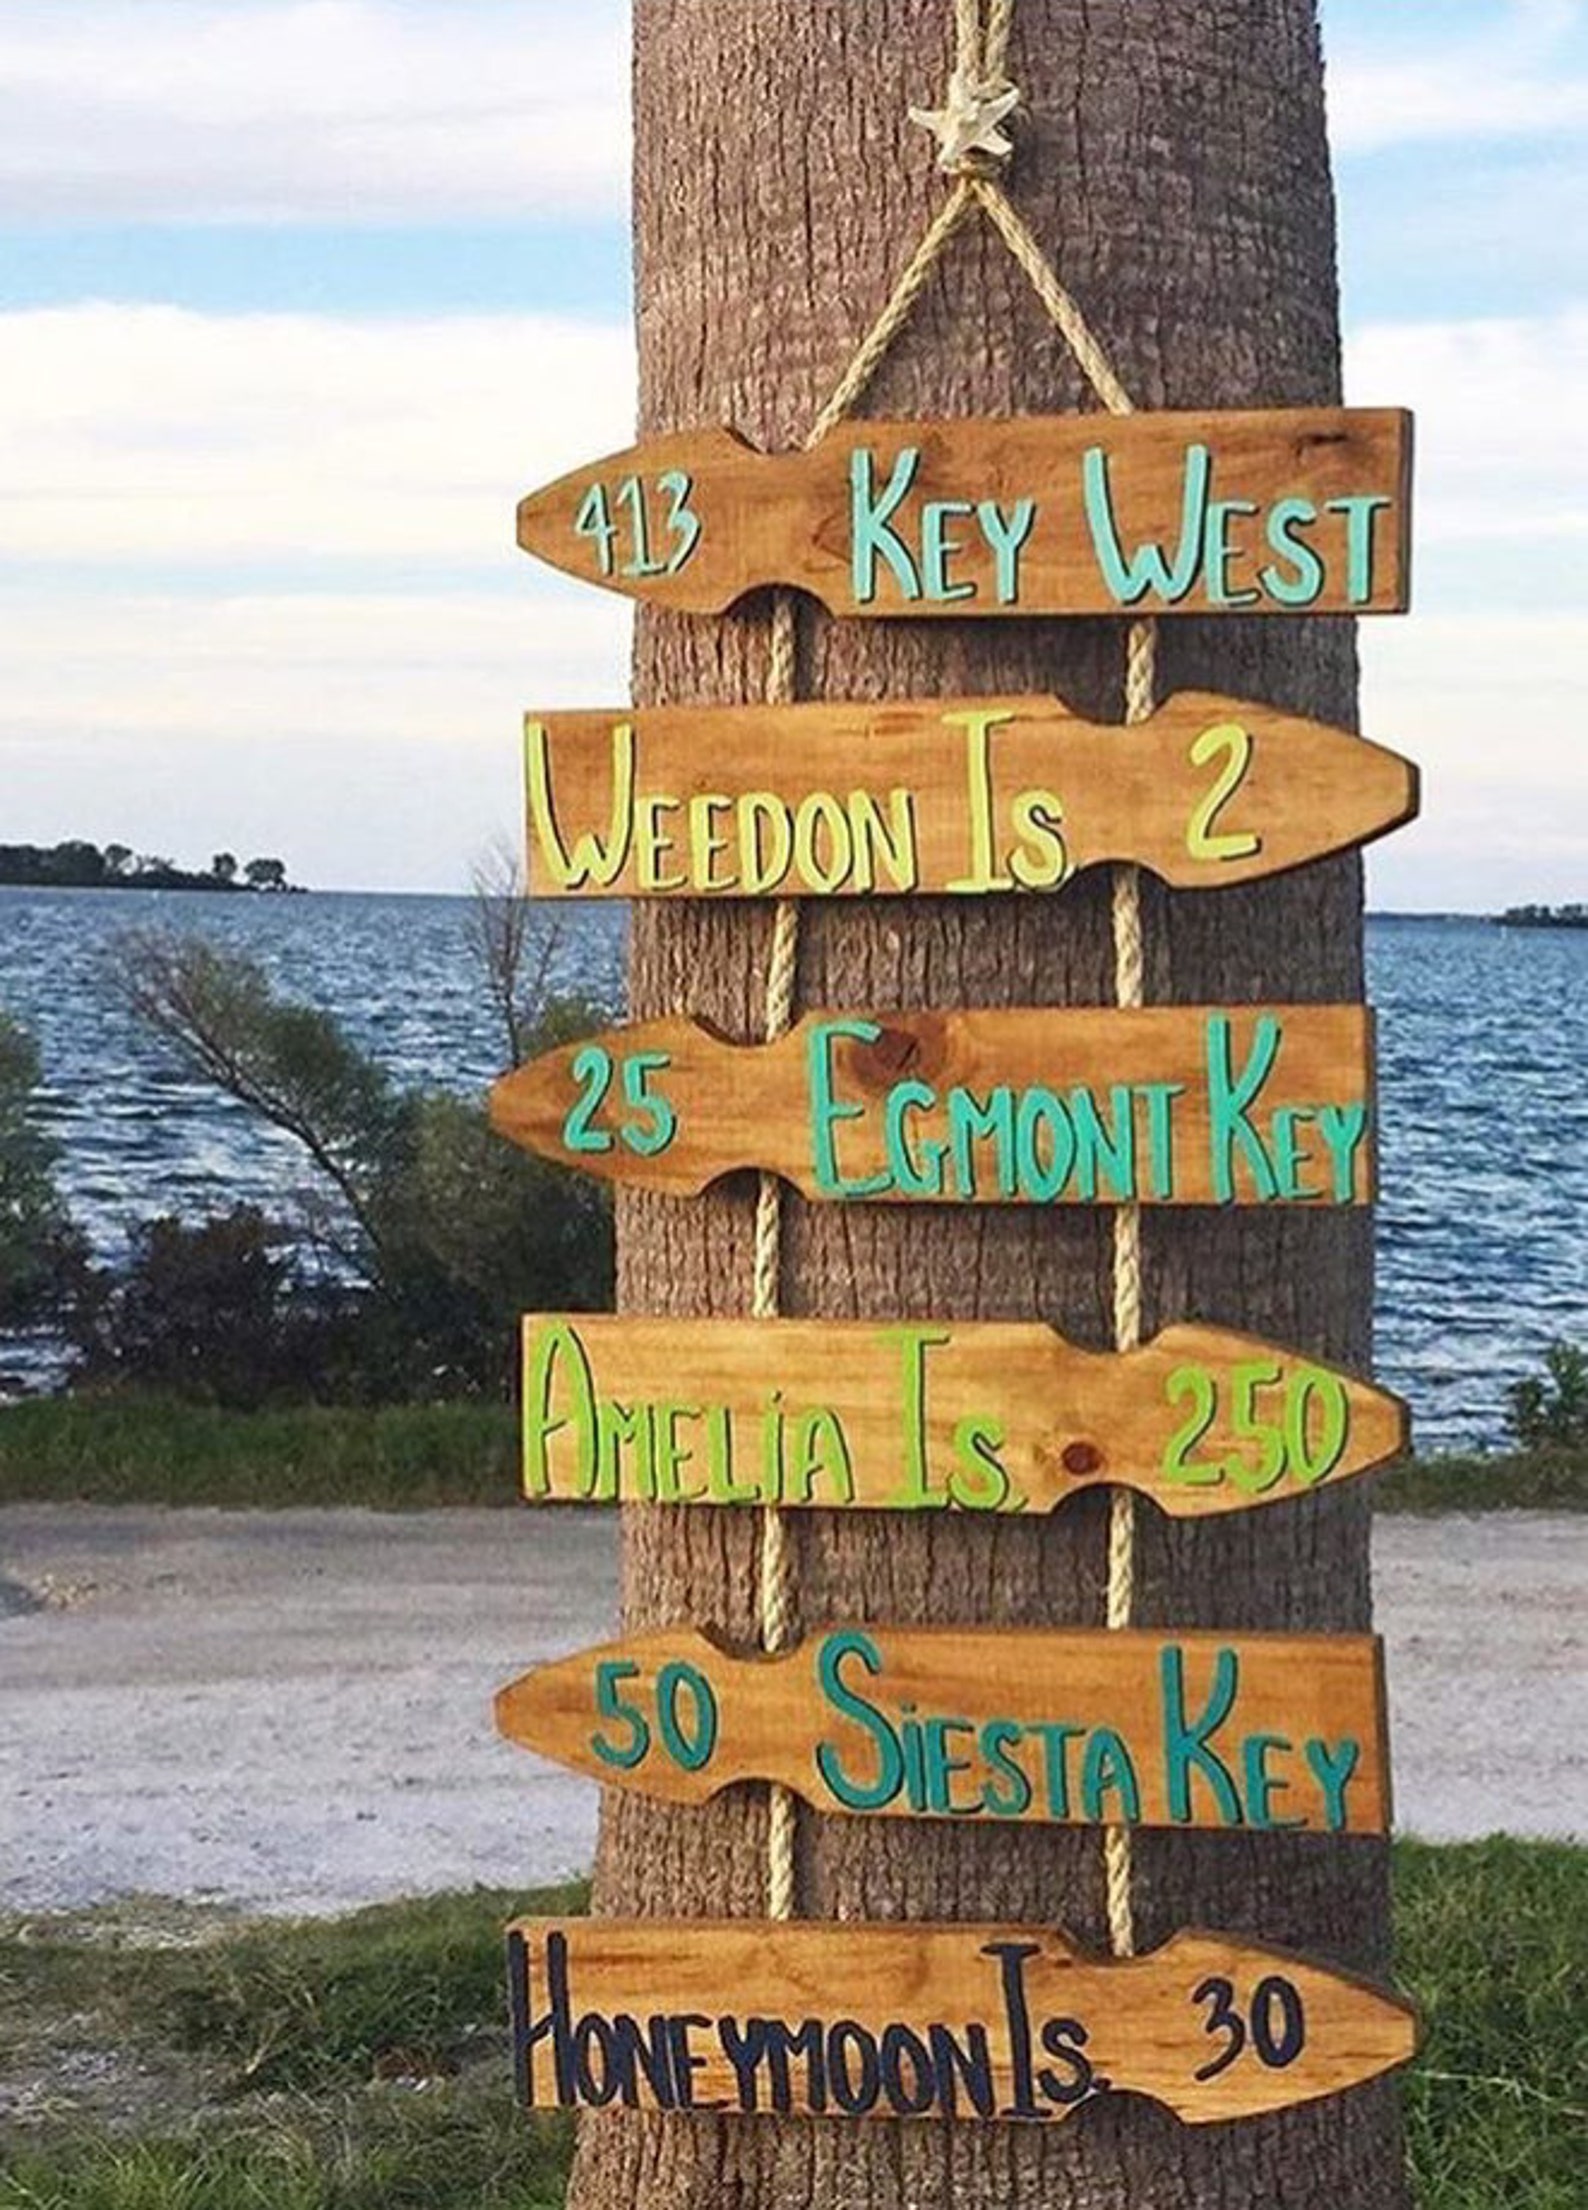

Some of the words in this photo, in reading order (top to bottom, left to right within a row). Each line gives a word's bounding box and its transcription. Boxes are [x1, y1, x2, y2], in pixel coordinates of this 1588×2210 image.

[572, 470, 702, 578] 413
[1185, 724, 1261, 863] 2
[562, 1049, 676, 1156] 25
[1160, 1362, 1350, 1492] 250
[590, 1660, 719, 1771] 50
[1190, 1974, 1306, 2082] 30
